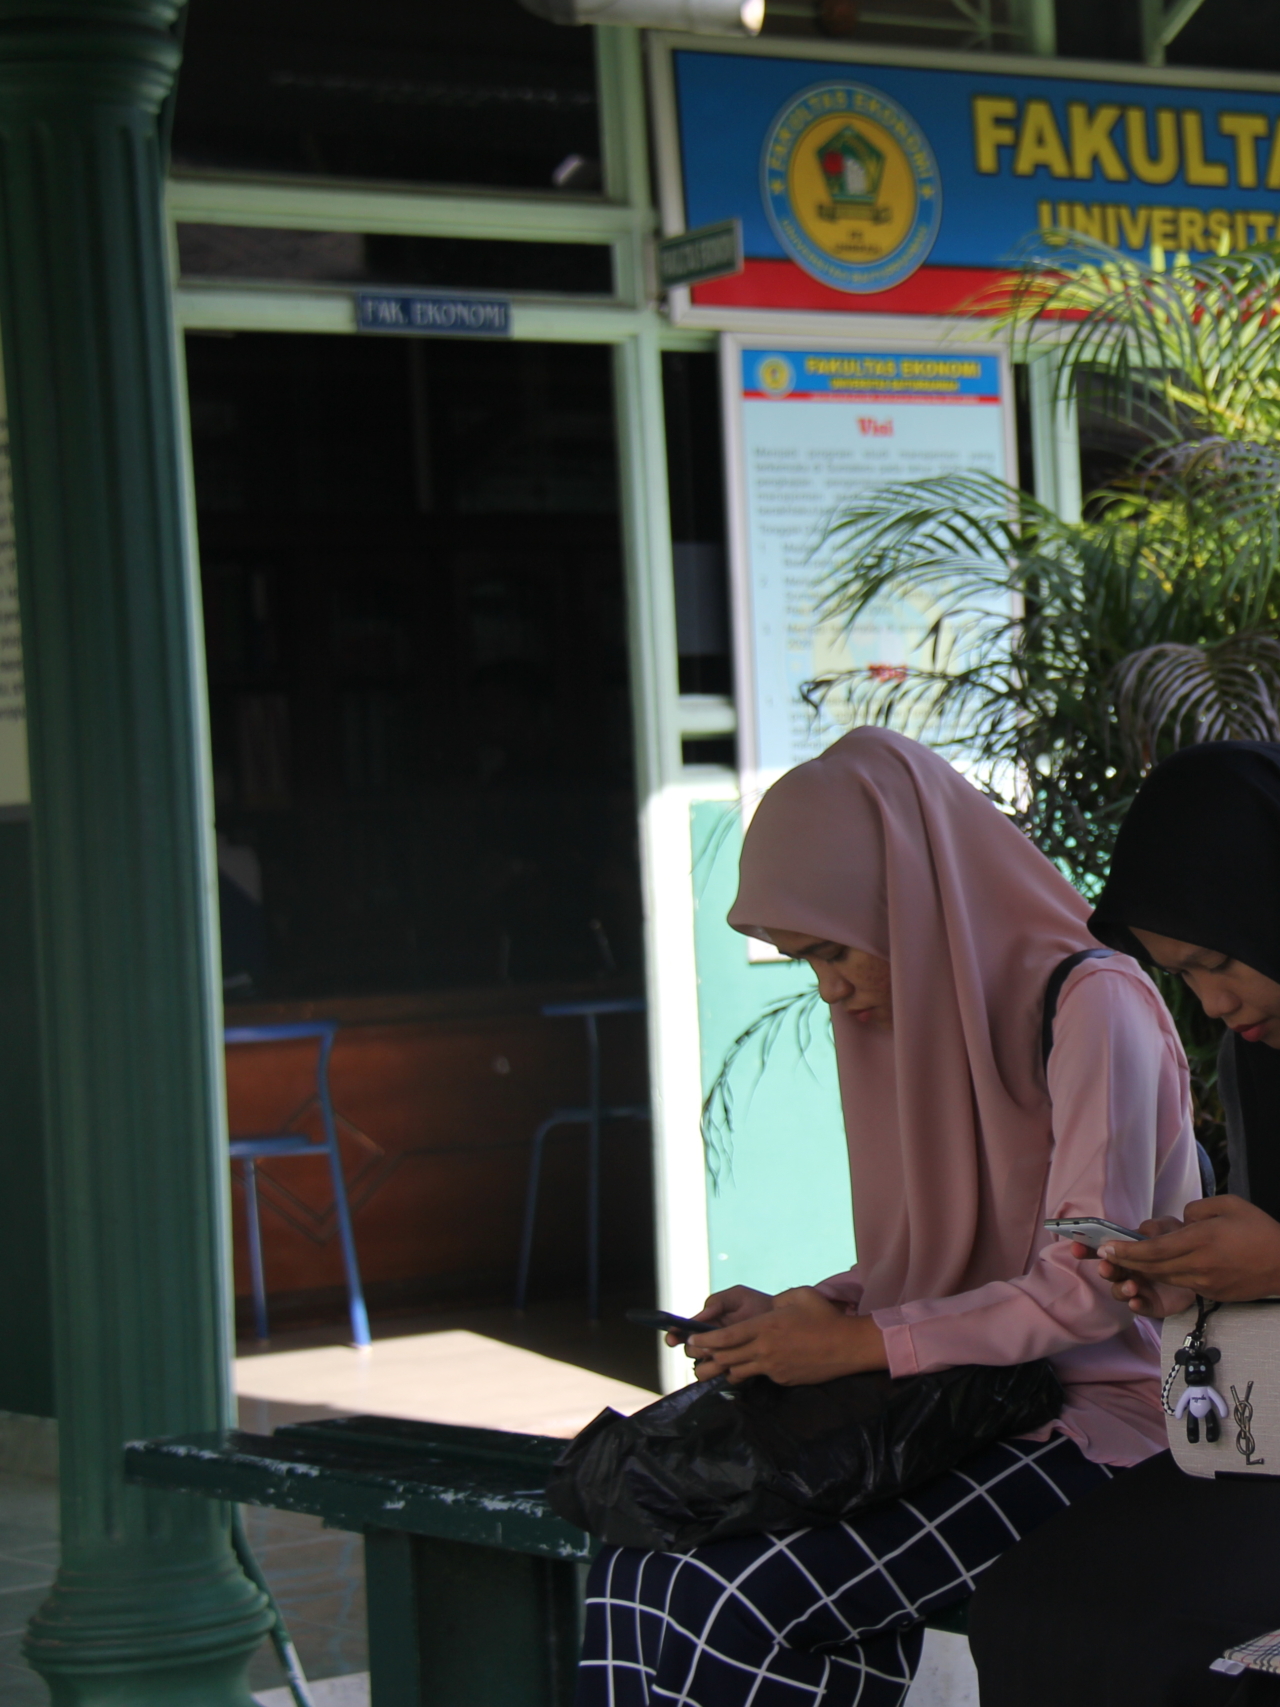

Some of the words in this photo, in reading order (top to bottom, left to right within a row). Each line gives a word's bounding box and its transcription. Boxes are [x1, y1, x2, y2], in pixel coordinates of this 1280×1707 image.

[415, 301, 507, 329] EKONOMI
[805, 356, 897, 378] FAKULTAS
[901, 360, 982, 379] EKONOMI
